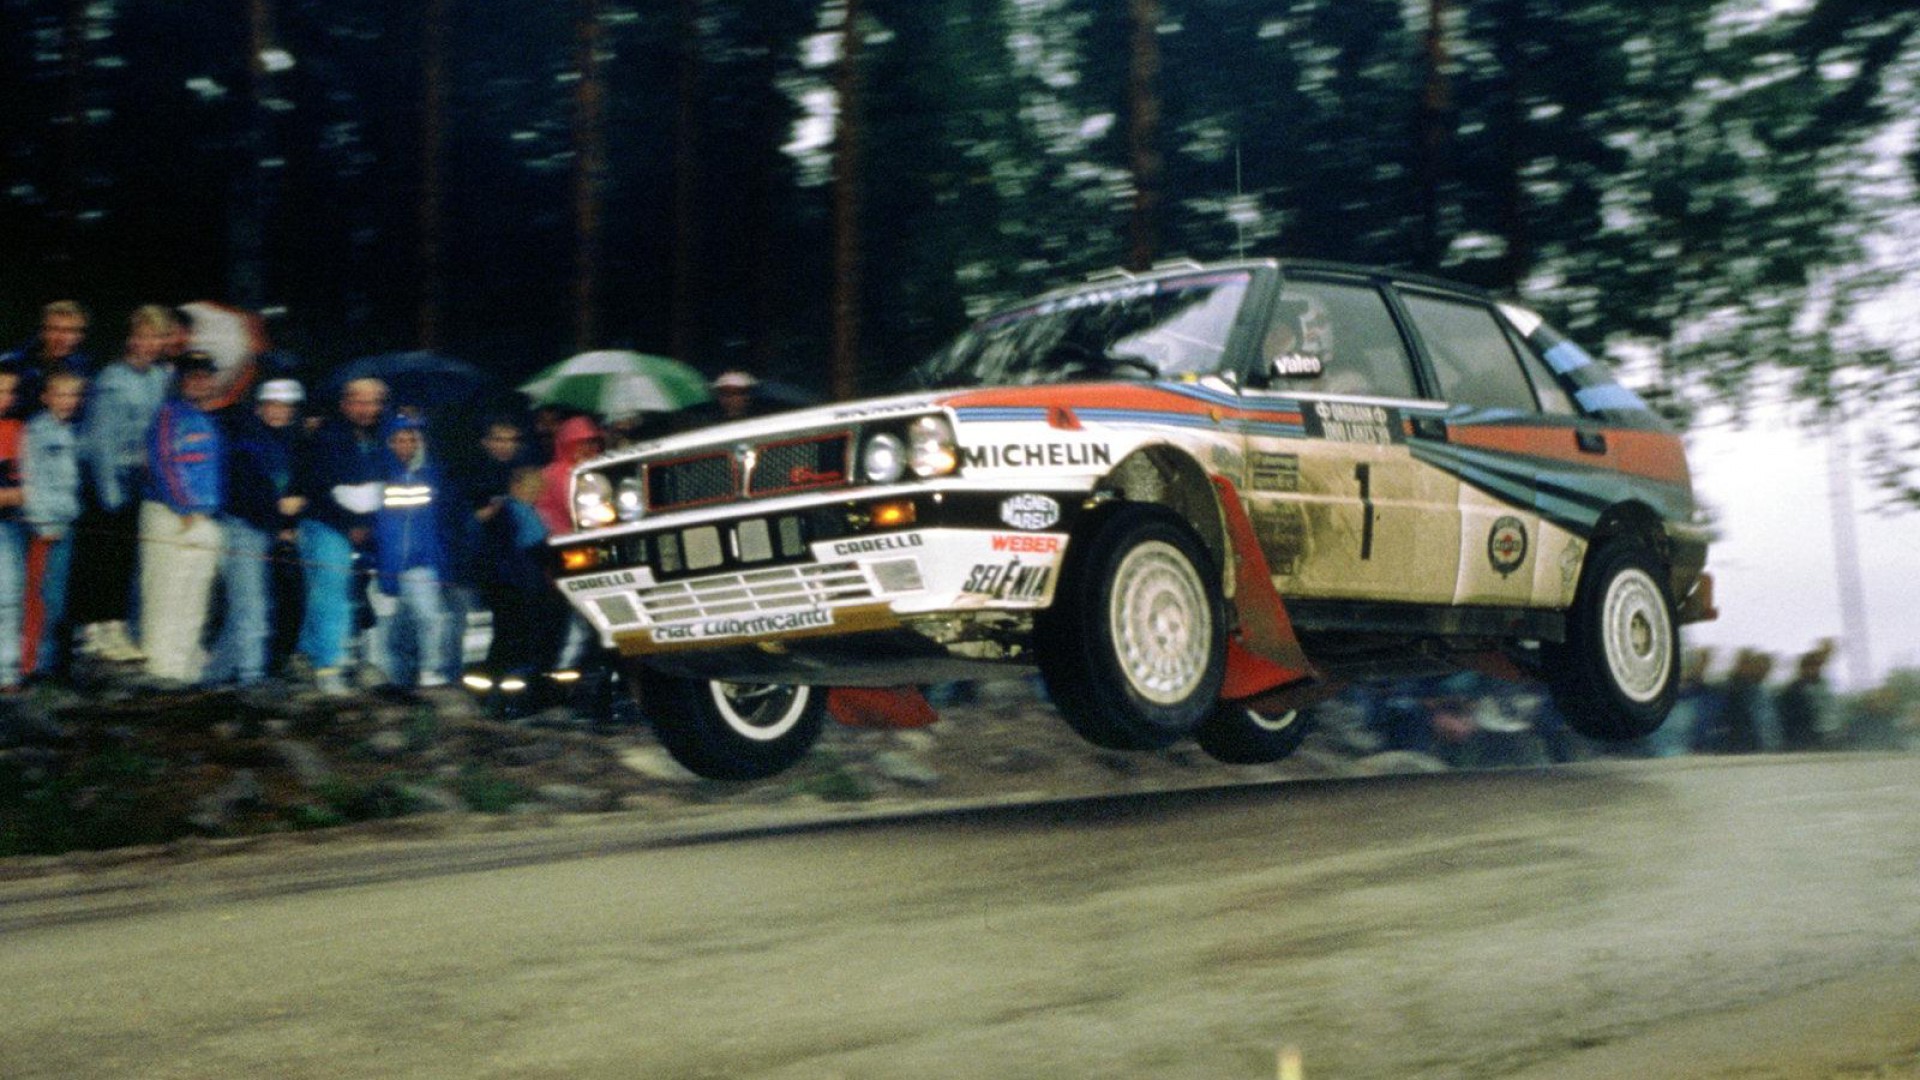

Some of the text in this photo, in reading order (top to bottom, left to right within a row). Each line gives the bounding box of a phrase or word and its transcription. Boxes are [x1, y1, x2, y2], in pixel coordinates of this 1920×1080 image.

[959, 442, 1112, 469] MICHELIN
[1355, 463, 1374, 560] 1
[834, 533, 923, 556] CARELLO
[992, 535, 1060, 553] WEBER
[567, 571, 636, 592] CARELLO
